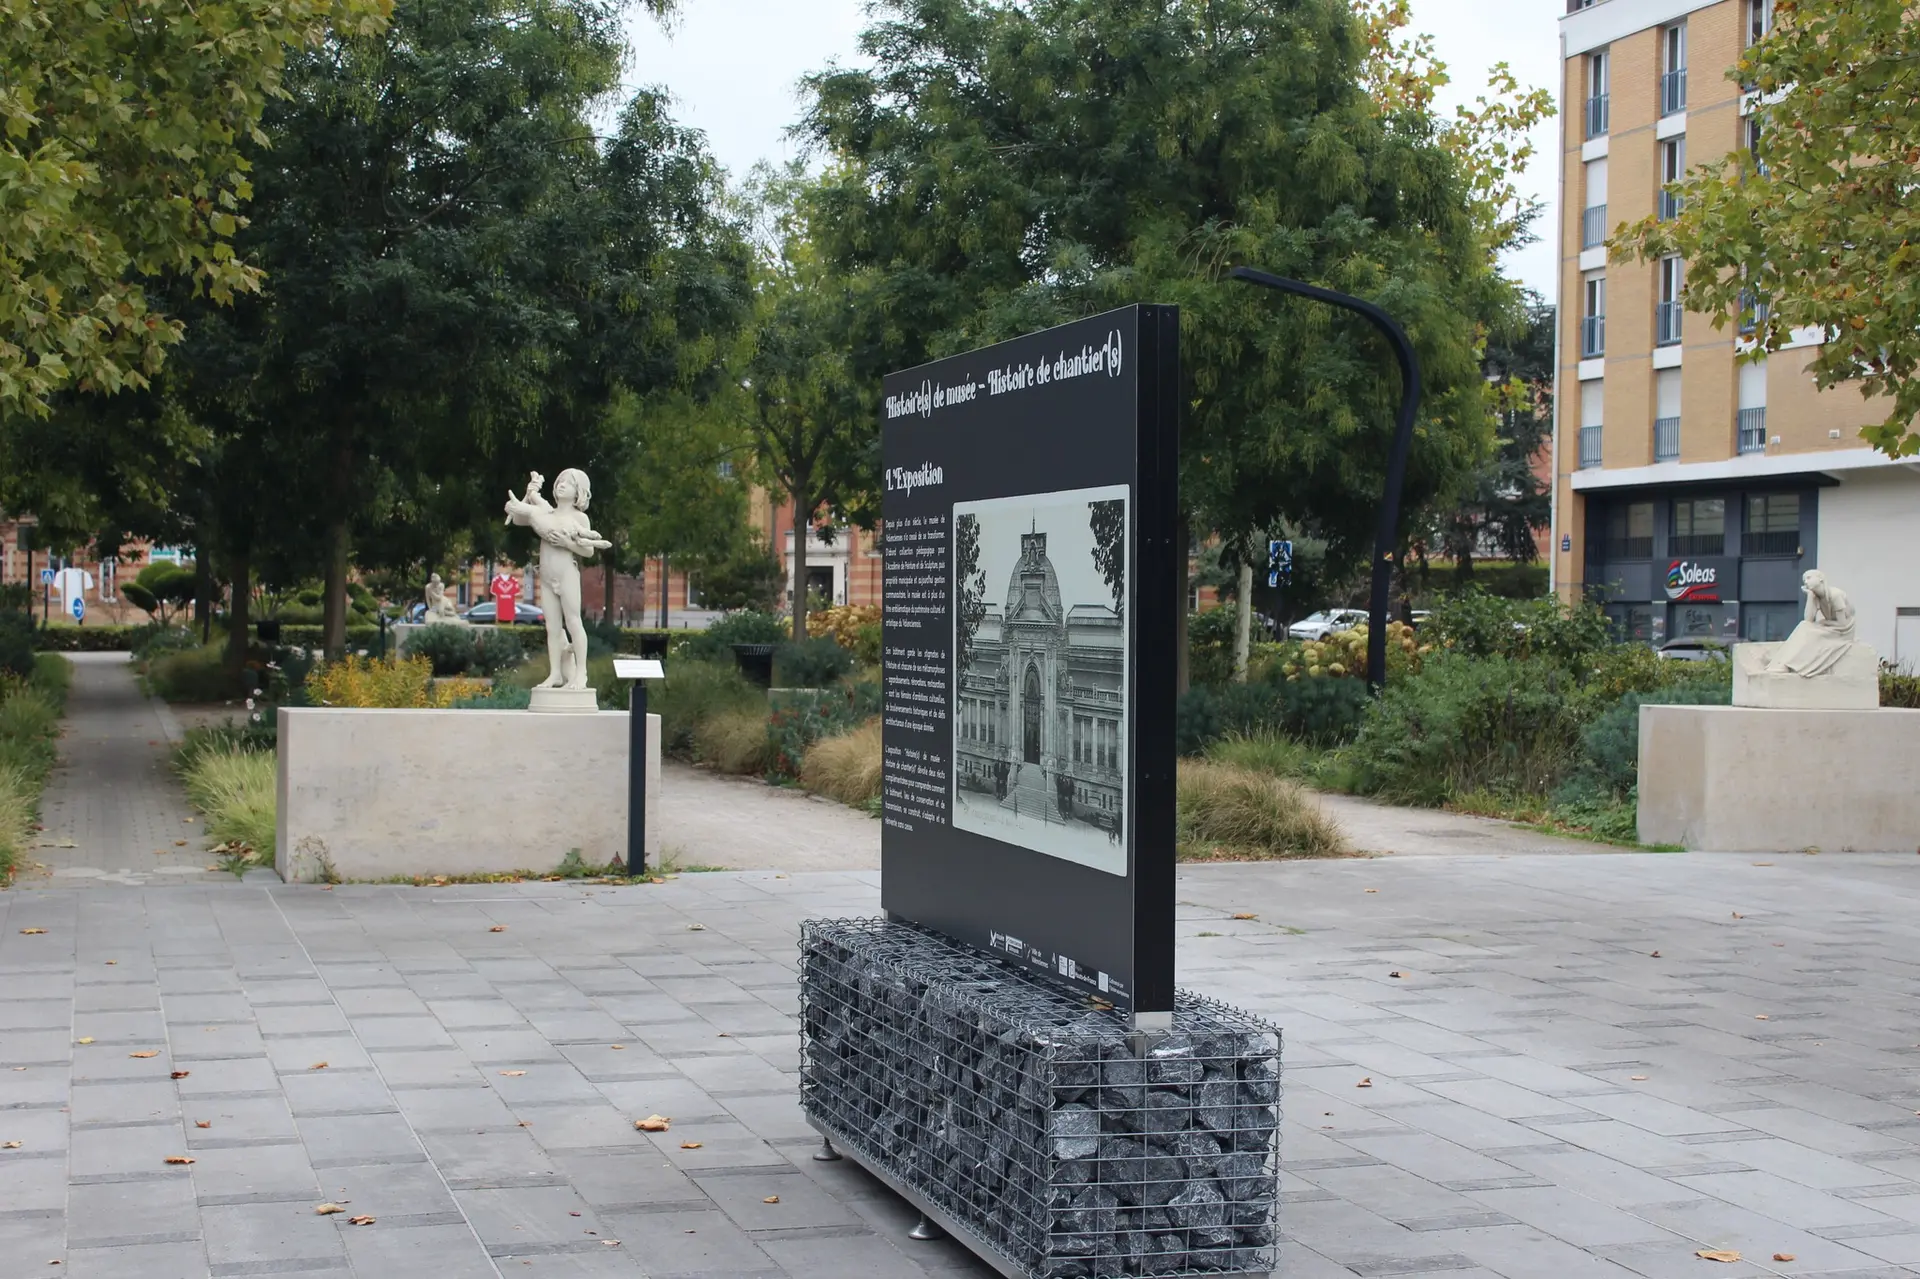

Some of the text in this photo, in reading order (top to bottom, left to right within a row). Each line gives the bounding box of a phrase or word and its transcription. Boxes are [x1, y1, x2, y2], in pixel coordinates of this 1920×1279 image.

[885, 379, 931, 419] Histoire(s)
[933, 382, 945, 408] de
[946, 372, 976, 405] musée
[988, 363, 1034, 395] Histoire
[1036, 355, 1051, 385] de
[1053, 329, 1122, 381] chantier(s)
[885, 460, 943, 498] L'Exposition
[1678, 561, 1716, 585] Soleas
